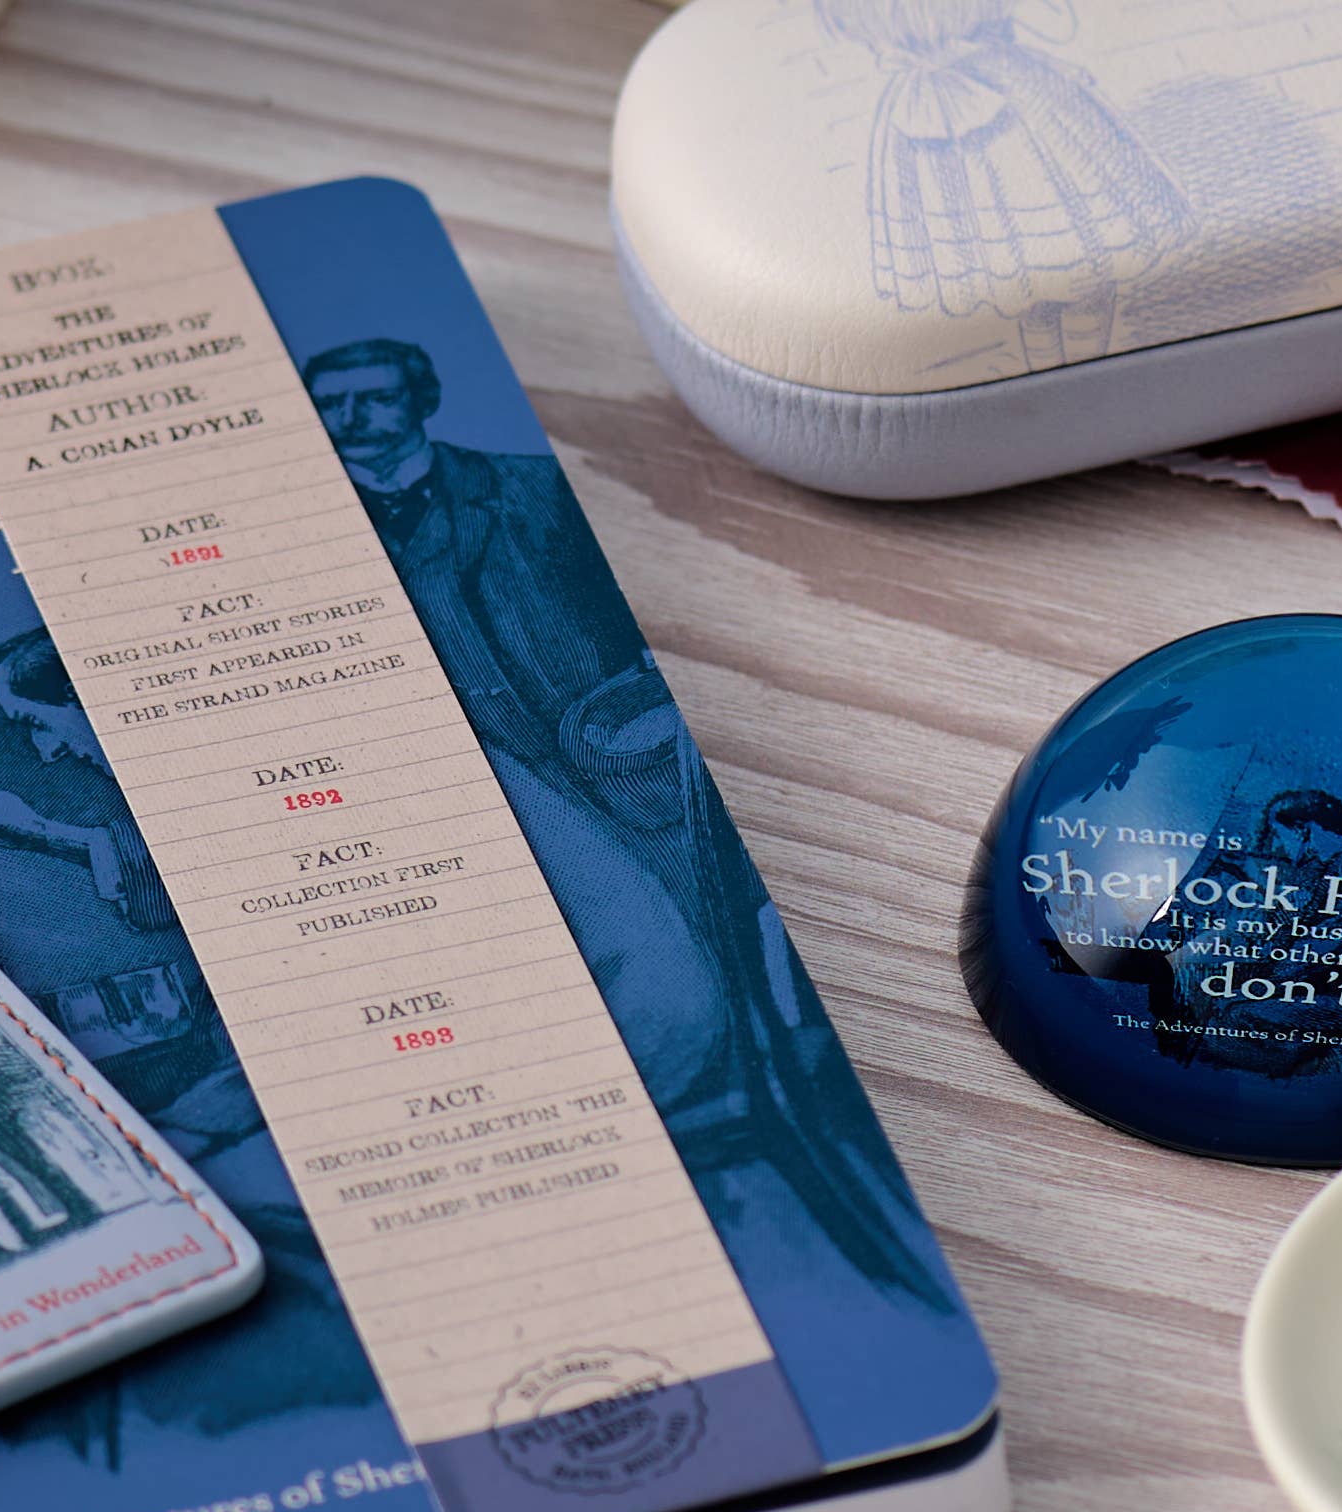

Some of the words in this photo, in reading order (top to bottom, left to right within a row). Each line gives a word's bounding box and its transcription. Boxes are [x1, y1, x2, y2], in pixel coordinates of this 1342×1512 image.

[53, 305, 116, 330] THE
[178, 310, 213, 332] OF
[131, 334, 246, 373] HOLMES
[61, 430, 159, 464] CONAN
[169, 408, 264, 443] DOYLE
[138, 512, 227, 544] DATE:
[170, 544, 224, 567] 1891
[177, 594, 263, 622] FACT:
[83, 636, 204, 672] ORIGINAL
[208, 619, 282, 645] SHORT
[289, 596, 385, 630] STORIES
[131, 666, 198, 691] FIRST
[208, 637, 332, 677] APPEARED
[338, 631, 366, 649] IN
[118, 705, 169, 726] THE
[174, 681, 271, 715] STRAND
[276, 653, 406, 696] MAGAZINE
[252, 756, 345, 788] DATE:
[283, 787, 343, 812] 1892
[293, 840, 384, 871] FACT:
[1116, 826, 1207, 851] name
[1217, 829, 1242, 851] is
[240, 871, 390, 917] COLLECTION
[394, 856, 465, 882] FIRST
[1022, 853, 1299, 913] Sherlock
[298, 894, 438, 937] PUBLISHED
[1169, 909, 1194, 929] It
[1203, 911, 1229, 932] is
[1236, 918, 1283, 941] my
[1065, 929, 1092, 946] to
[1101, 928, 1180, 952] know
[1187, 936, 1263, 958] what
[361, 991, 455, 1026] DATE:
[392, 1026, 454, 1053] 1893
[1112, 1015, 1150, 1031] The
[1155, 1017, 1269, 1041] Adventures
[1274, 1028, 1298, 1042] of
[404, 1084, 496, 1118] FACT:
[304, 1141, 403, 1174] SECOND
[408, 1104, 561, 1152] COLLECTION
[339, 1165, 448, 1204] MEMOIRS
[454, 1156, 485, 1176] OF
[491, 1126, 623, 1167] SHERLOCK
[370, 1196, 471, 1232] HOLMES
[475, 1161, 621, 1208] PUBLISHED
[27, 1234, 204, 1315] Wonderland
[280, 1470, 326, 1509] of
